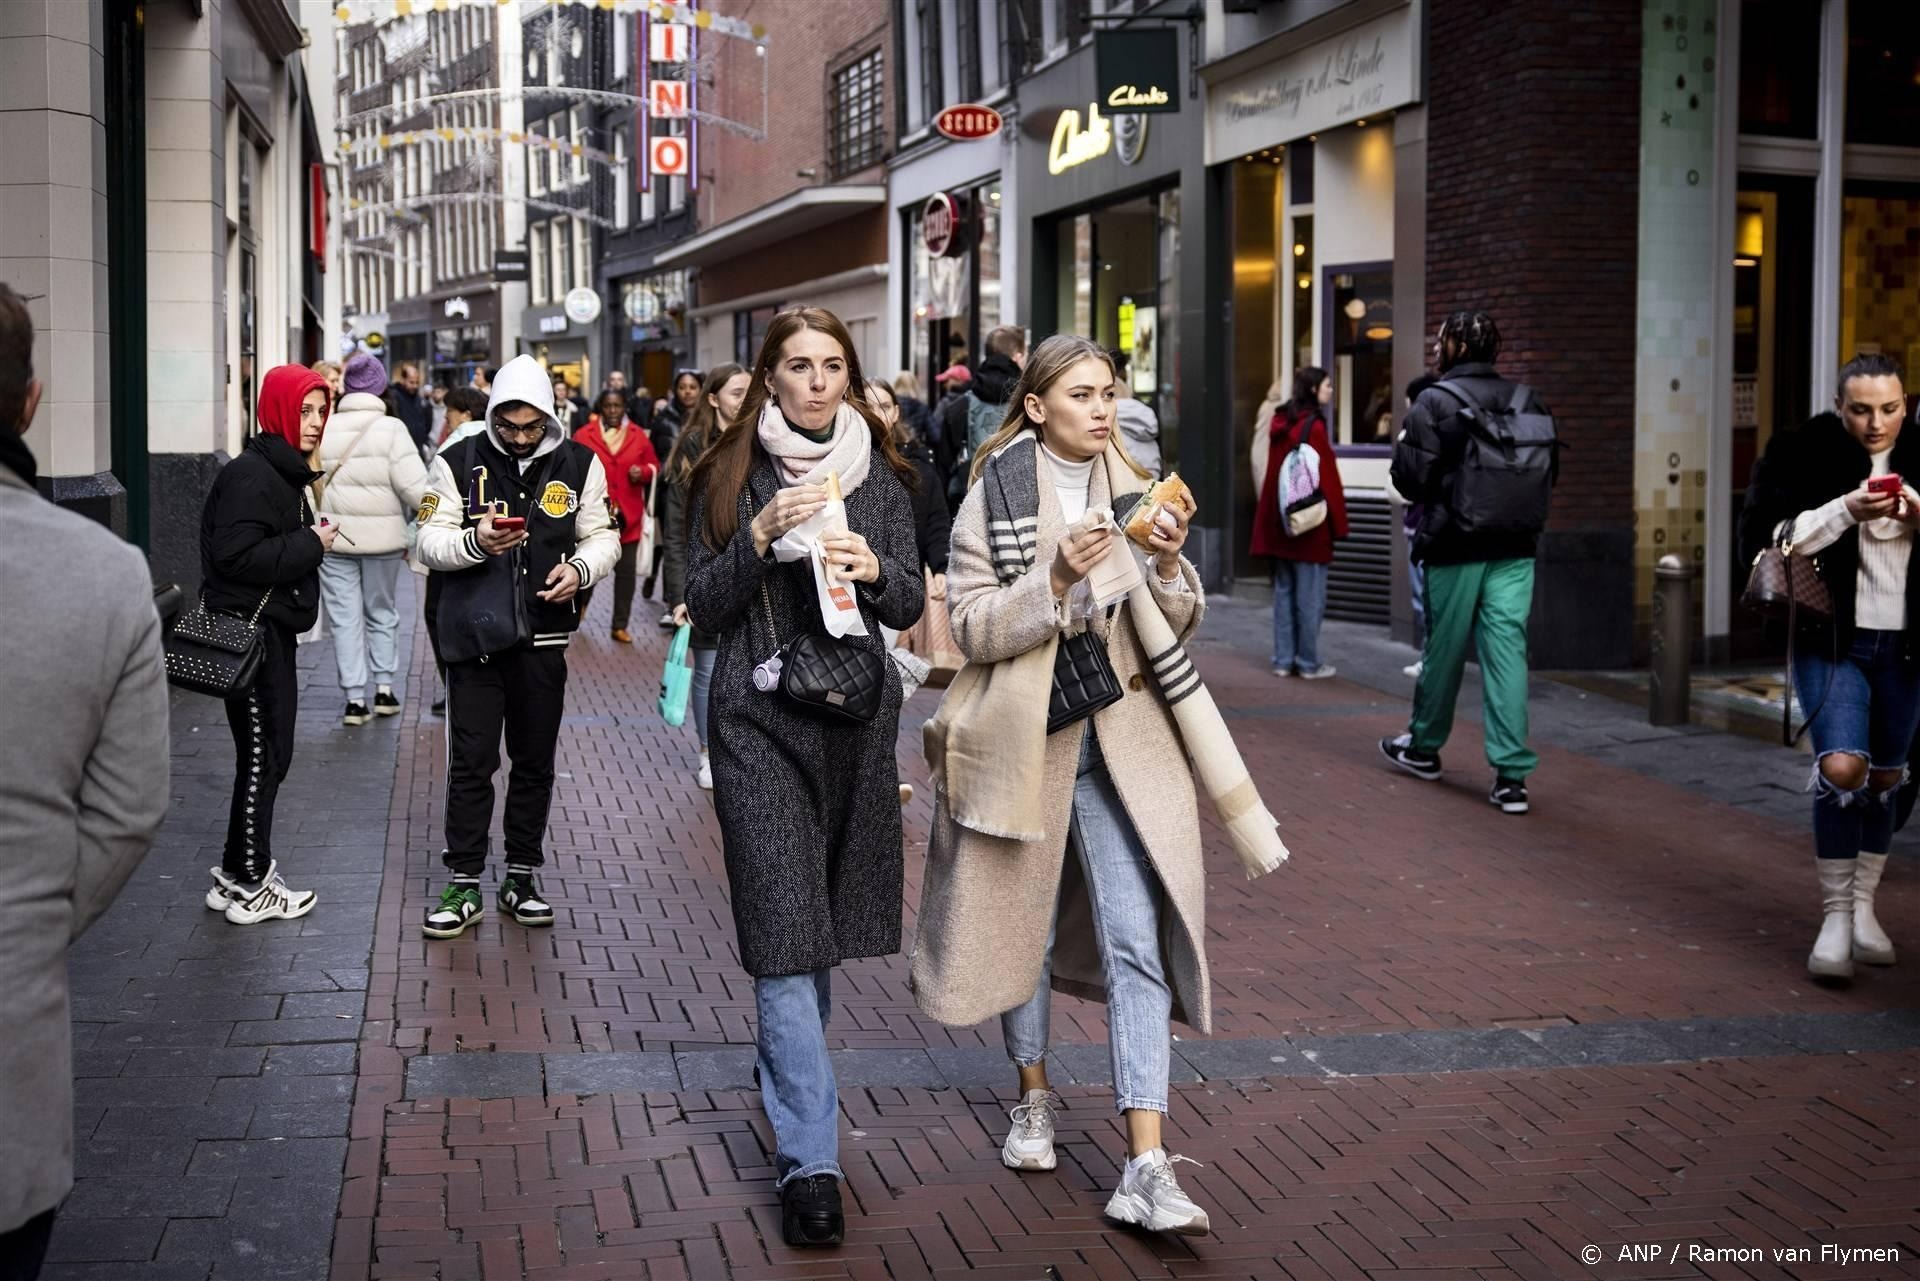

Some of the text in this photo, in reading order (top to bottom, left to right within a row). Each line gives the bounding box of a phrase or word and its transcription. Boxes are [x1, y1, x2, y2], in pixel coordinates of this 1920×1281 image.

[655, 0, 683, 173] INO
[1108, 85, 1168, 106] Clarks
[943, 112, 995, 132] SCORE
